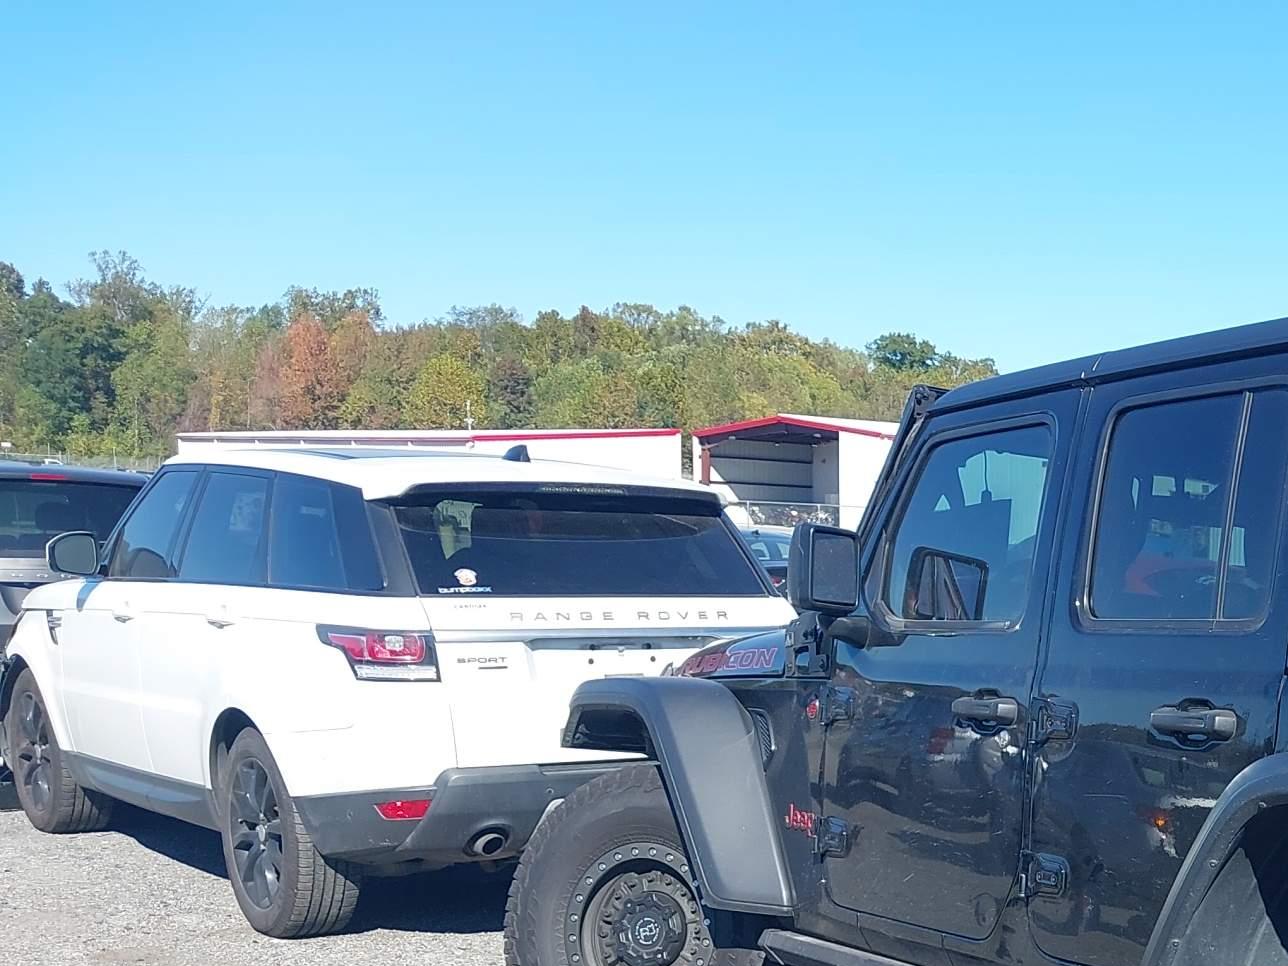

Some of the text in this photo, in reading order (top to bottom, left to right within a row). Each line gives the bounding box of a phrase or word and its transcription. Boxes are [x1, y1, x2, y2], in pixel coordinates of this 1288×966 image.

[509, 610, 729, 622] RANGE ROVER
[456, 656, 508, 664] SPORT
[682, 647, 778, 674] RUBICON
[784, 803, 816, 838] Jeep
